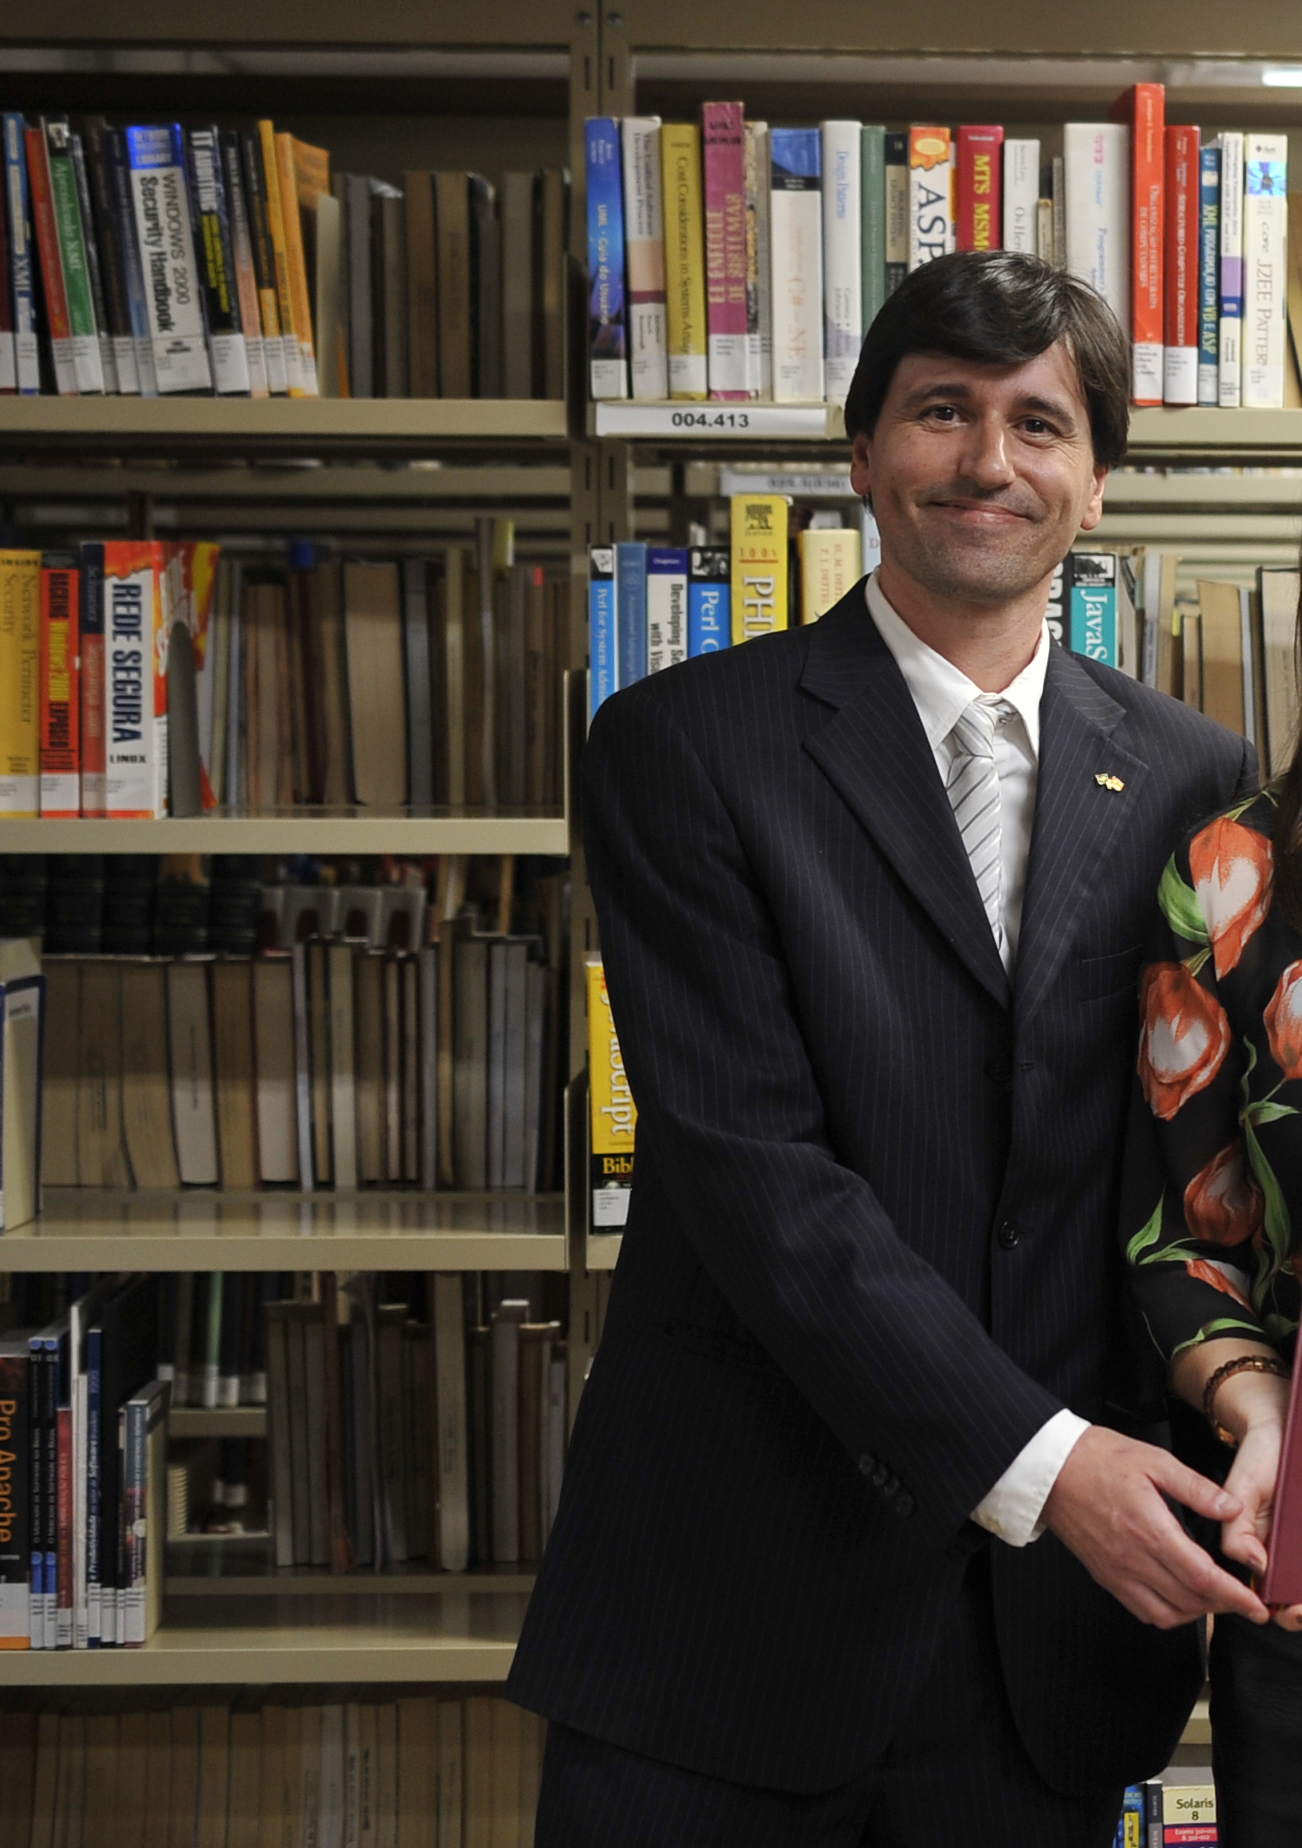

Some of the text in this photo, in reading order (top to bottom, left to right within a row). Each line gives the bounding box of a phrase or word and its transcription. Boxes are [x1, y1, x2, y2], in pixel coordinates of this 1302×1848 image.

[973, 154, 990, 195] MTS
[163, 174, 190, 305] WINDOWS 2000
[973, 203, 990, 252] MSM
[140, 176, 157, 248] Security
[151, 251, 175, 332] Handbook
[1254, 257, 1272, 302] J2EE
[672, 411, 749, 430] 004.413
[596, 588, 609, 666] Perl for System
[667, 583, 684, 646] Developing
[700, 590, 721, 632] Perl
[650, 622, 664, 646] with
[112, 583, 143, 743] REDE SEGURA
[109, 754, 147, 764] LINUX
[0, 1399, 17, 1441] Pro
[1176, 1798, 1214, 1810] Solaris
[1191, 1811, 1199, 1821] 8
